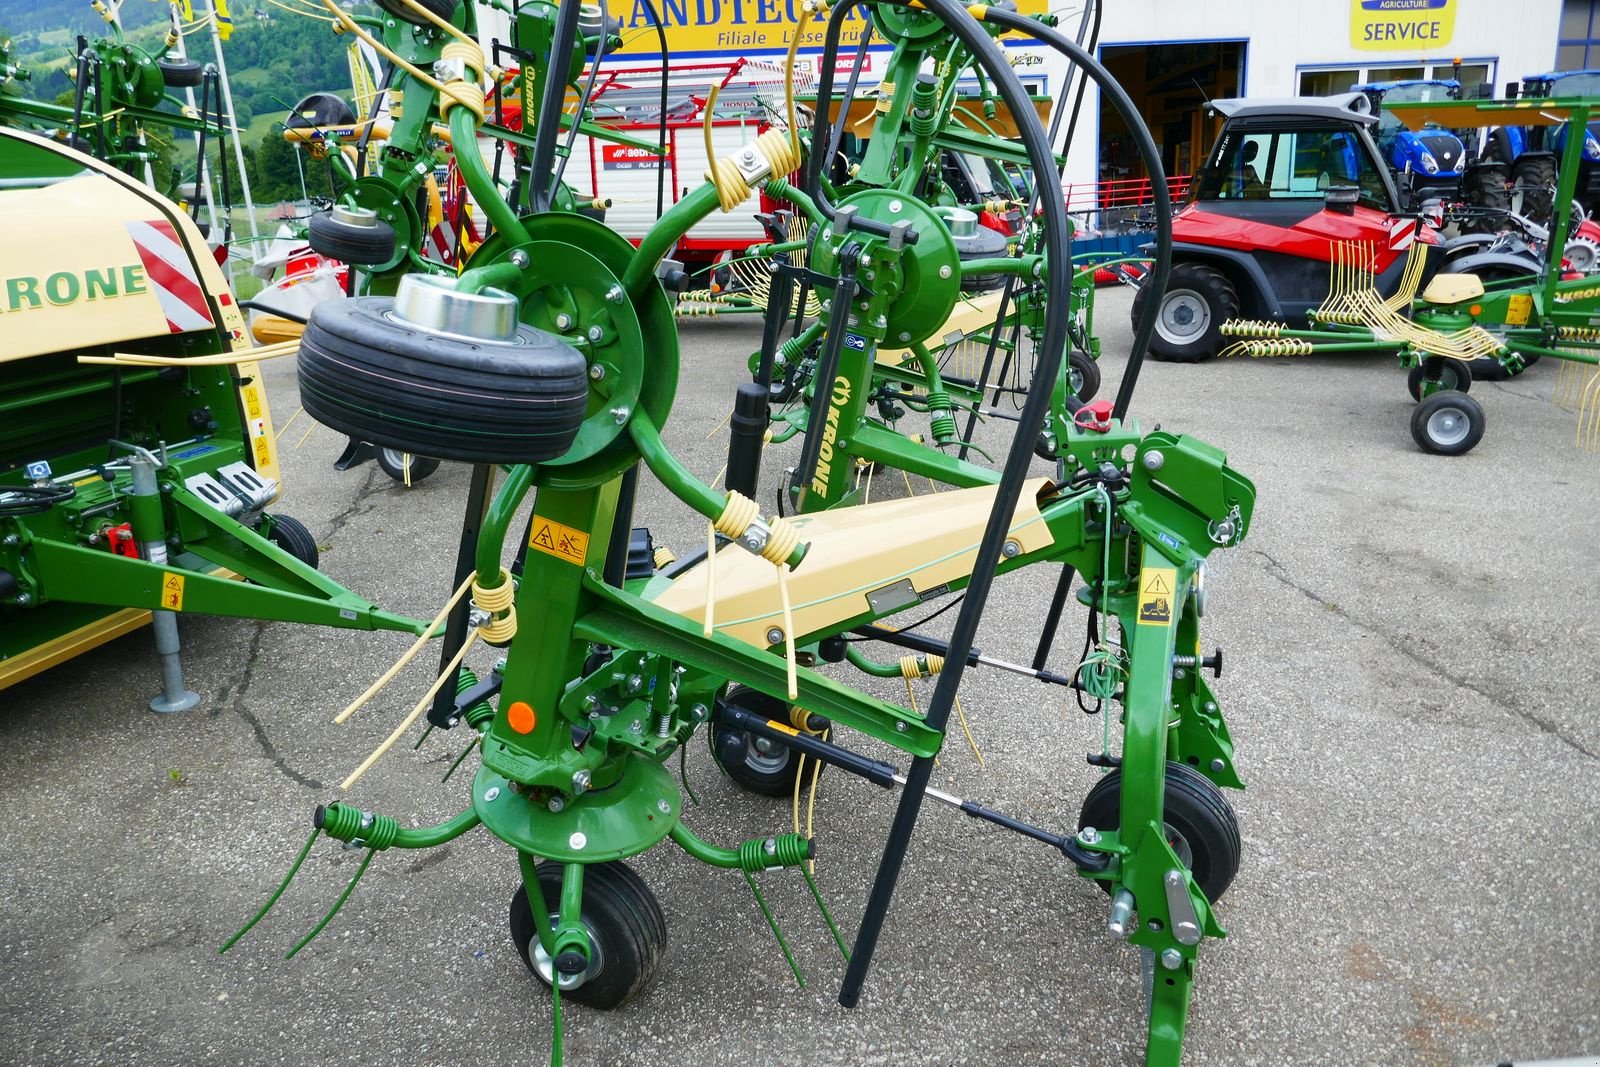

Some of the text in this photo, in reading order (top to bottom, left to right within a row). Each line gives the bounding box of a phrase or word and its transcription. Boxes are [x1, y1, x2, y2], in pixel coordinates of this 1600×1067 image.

[1380, 0, 1427, 9] AGRICULTURE
[717, 29, 767, 46] Filiale
[1363, 21, 1441, 41] SERVICE
[525, 79, 535, 127] KRONE
[722, 100, 757, 108] HONDA
[0, 264, 147, 314] RONE
[811, 405, 840, 499] KRONE
